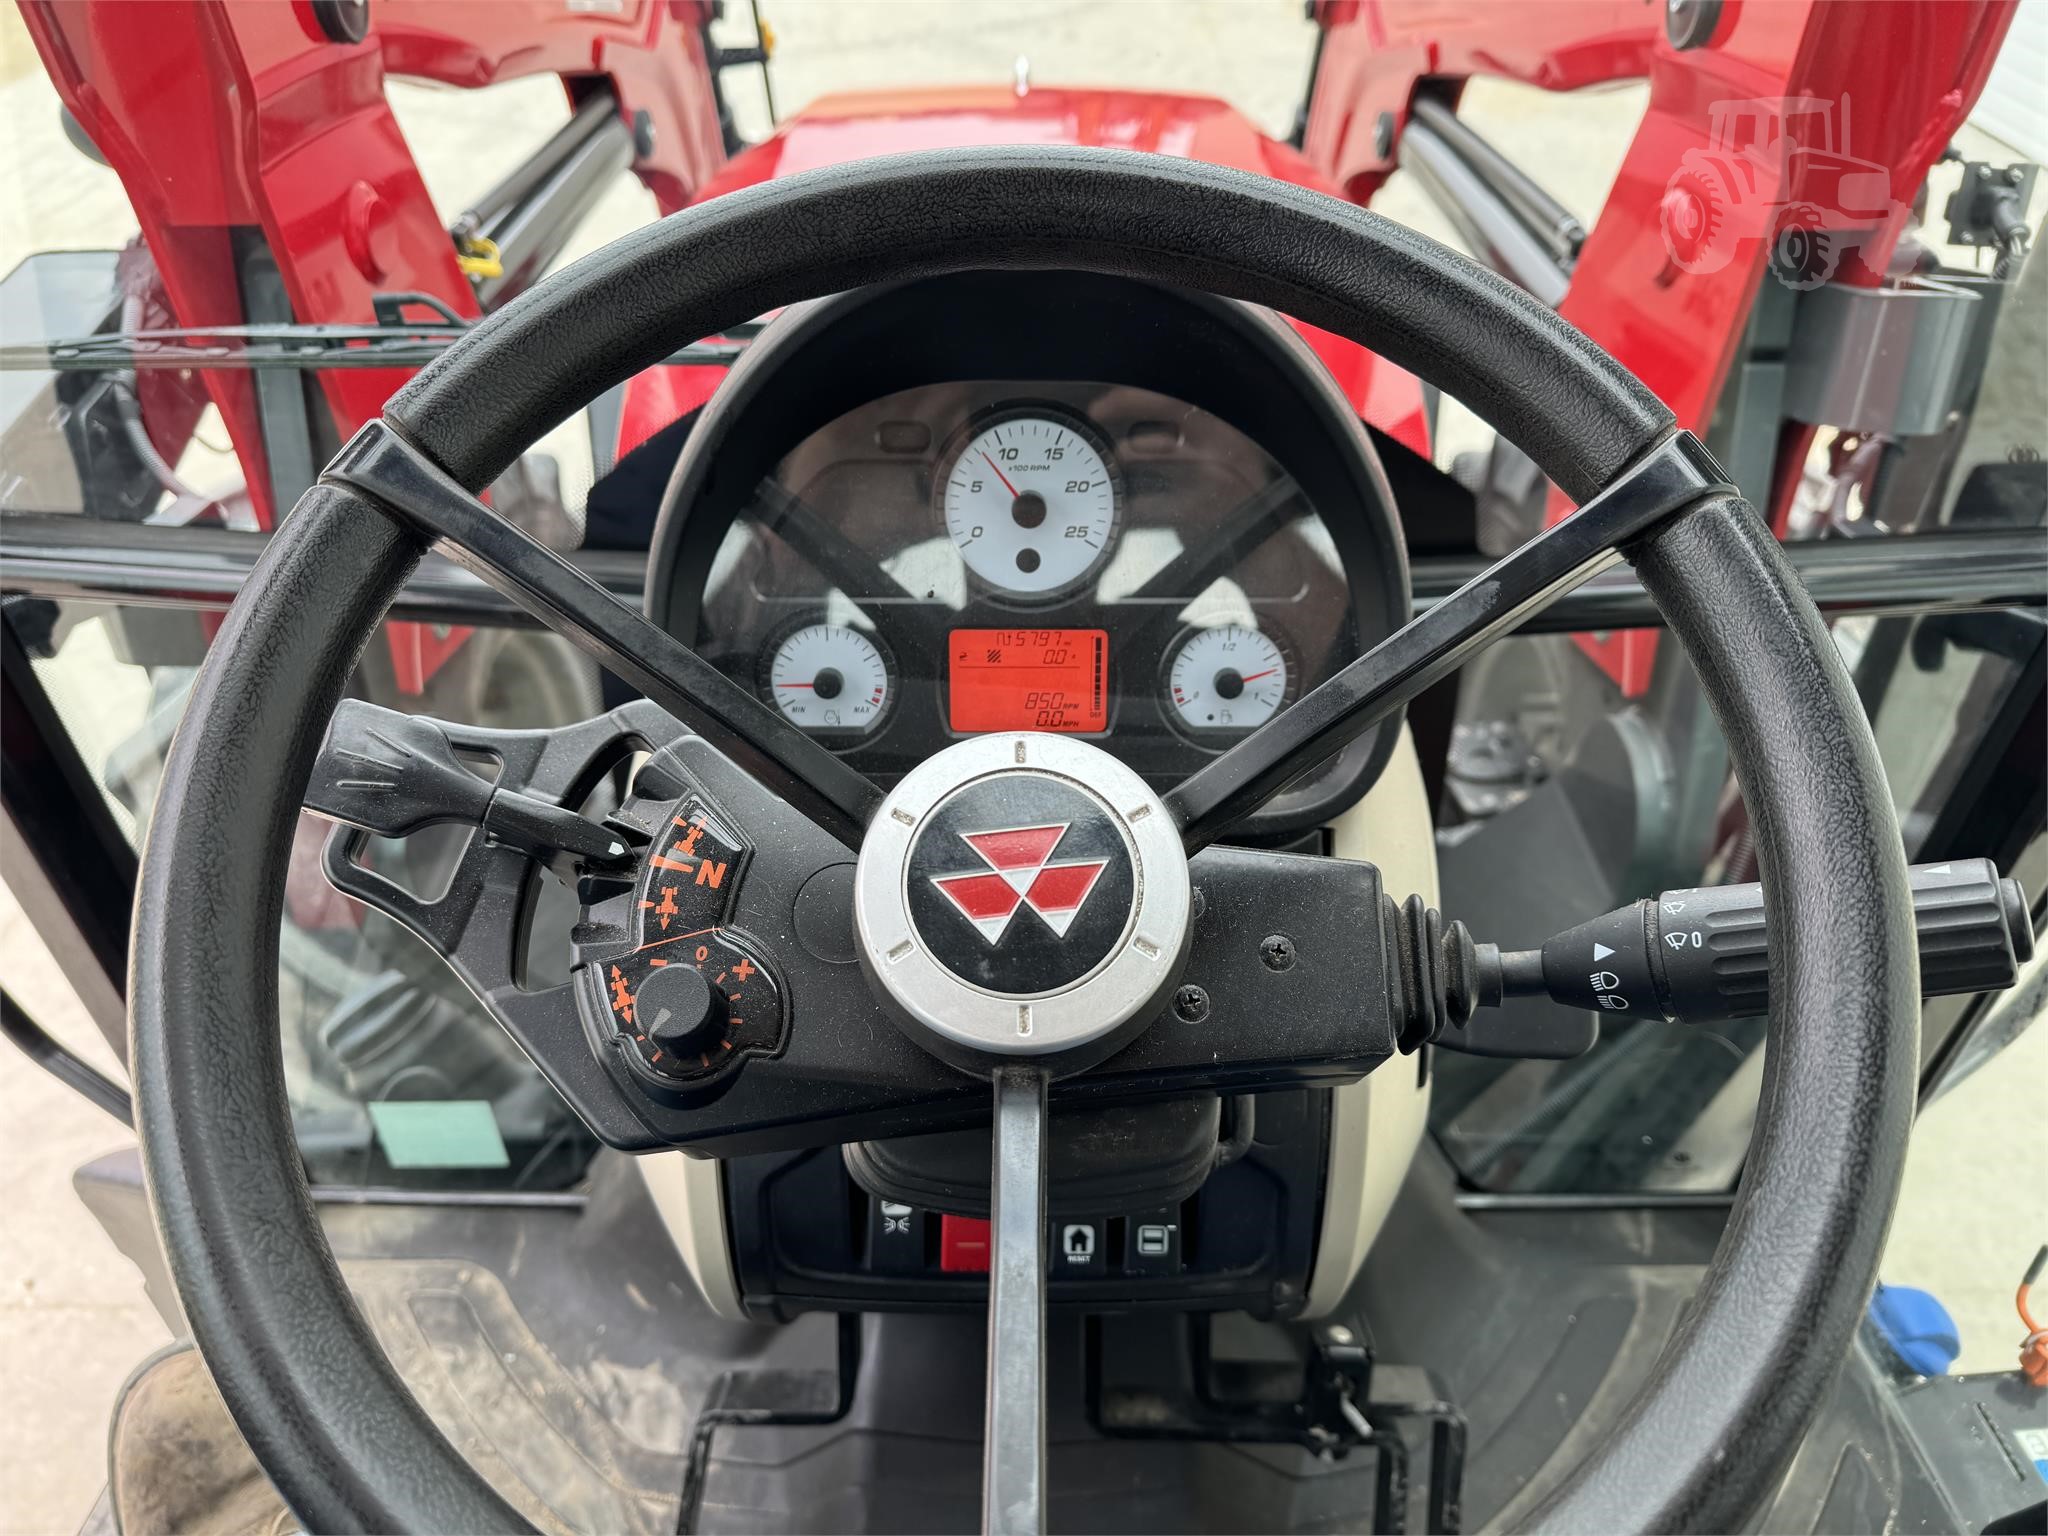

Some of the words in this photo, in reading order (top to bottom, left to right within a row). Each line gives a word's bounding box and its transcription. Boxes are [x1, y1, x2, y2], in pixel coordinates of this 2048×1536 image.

[998, 448, 1019, 460] 10
[1044, 448, 1064, 460] 15
[971, 481, 983, 493] 5
[1065, 481, 1090, 493] 20
[971, 526, 983, 538] 0
[1064, 526, 1088, 538] 25
[1025, 692, 1065, 709] 850
[1036, 711, 1064, 727] 0.0
[695, 859, 727, 889] N
